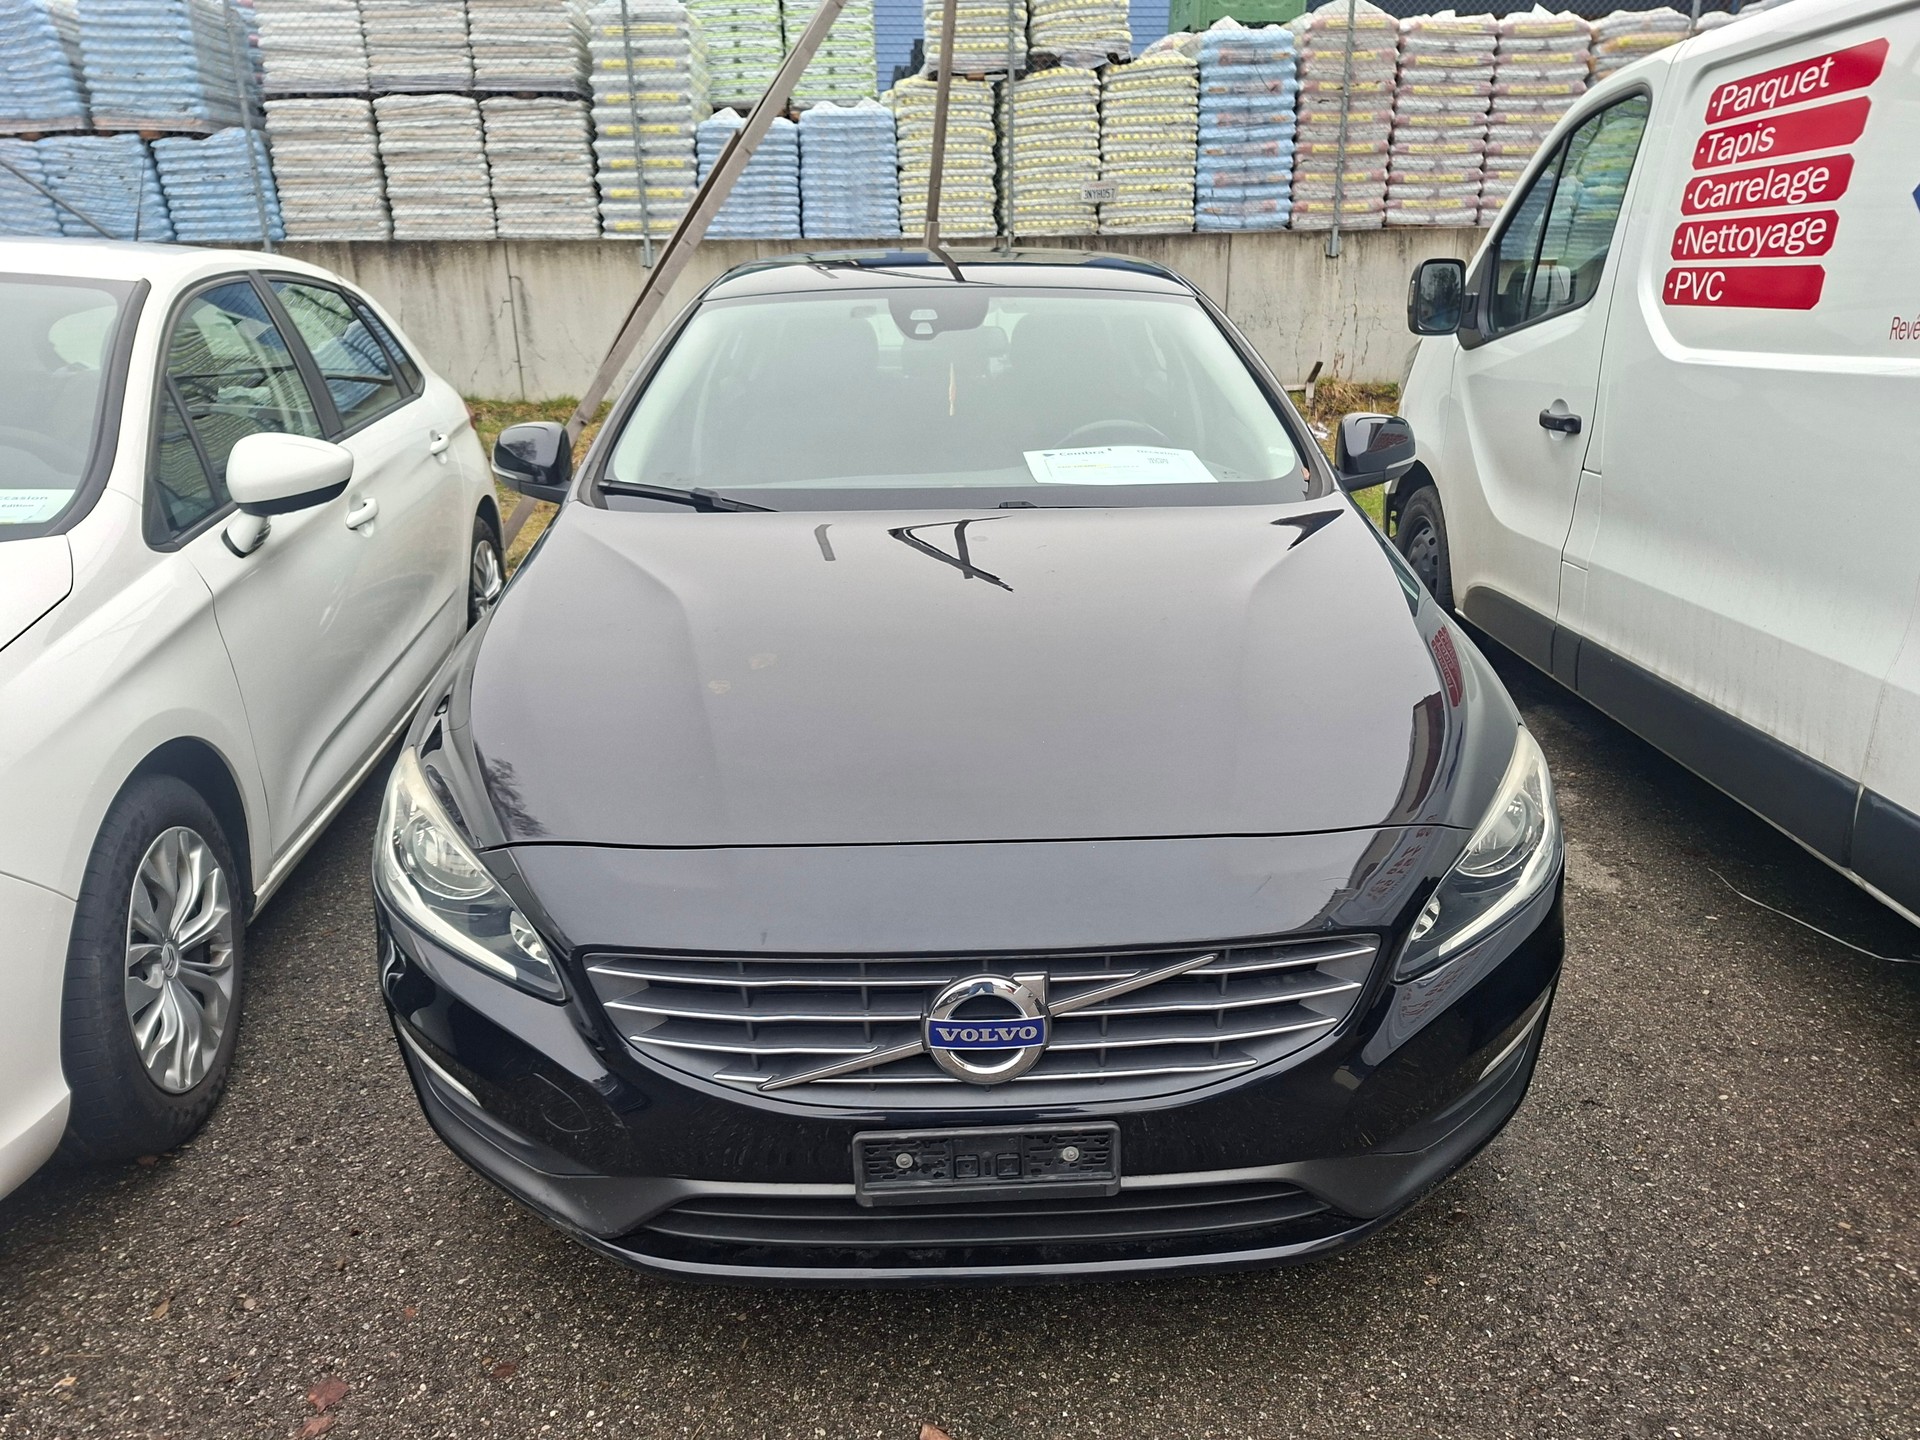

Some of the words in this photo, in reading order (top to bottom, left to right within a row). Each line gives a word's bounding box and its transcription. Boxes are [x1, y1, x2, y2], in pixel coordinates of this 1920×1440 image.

[1716, 56, 1836, 117] Parquet
[1707, 122, 1777, 164] Tapis
[1693, 166, 1830, 210] Carrelage
[1682, 217, 1827, 258] Nettoyage
[1673, 270, 1726, 301] PVC
[935, 1025, 1038, 1042] VOLVO
